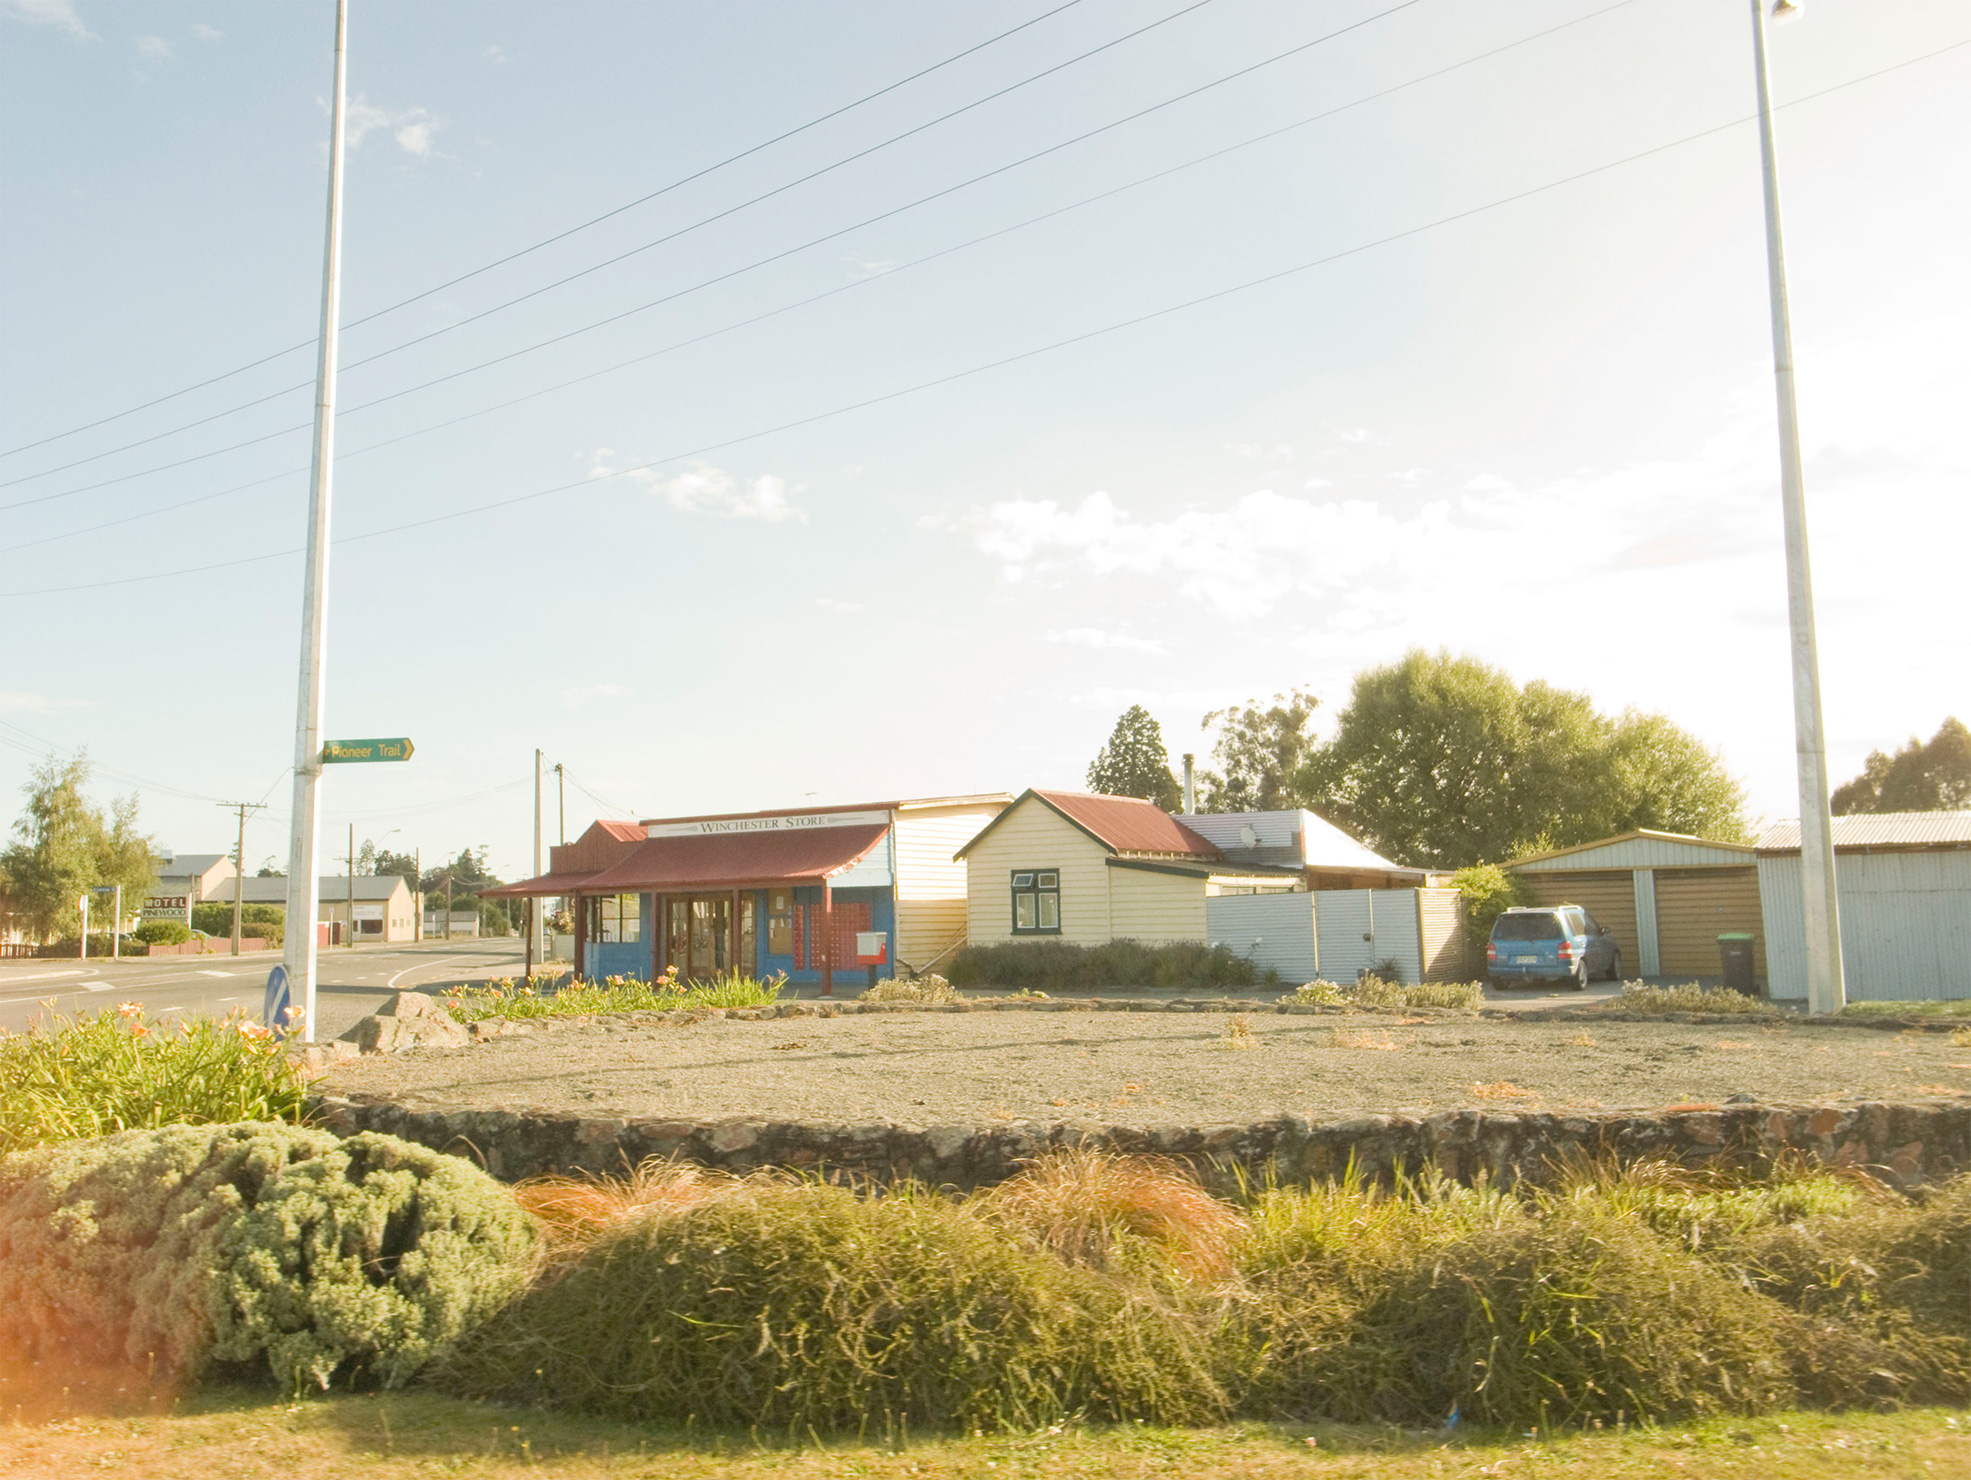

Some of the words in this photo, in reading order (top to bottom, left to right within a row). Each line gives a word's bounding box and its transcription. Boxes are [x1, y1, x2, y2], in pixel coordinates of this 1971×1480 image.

[331, 745, 372, 758] Pioneer
[378, 744, 401, 757] Trail
[701, 819, 779, 833] WINCHESTER
[786, 816, 825, 829] STORE
[144, 898, 186, 907] MOTEL
